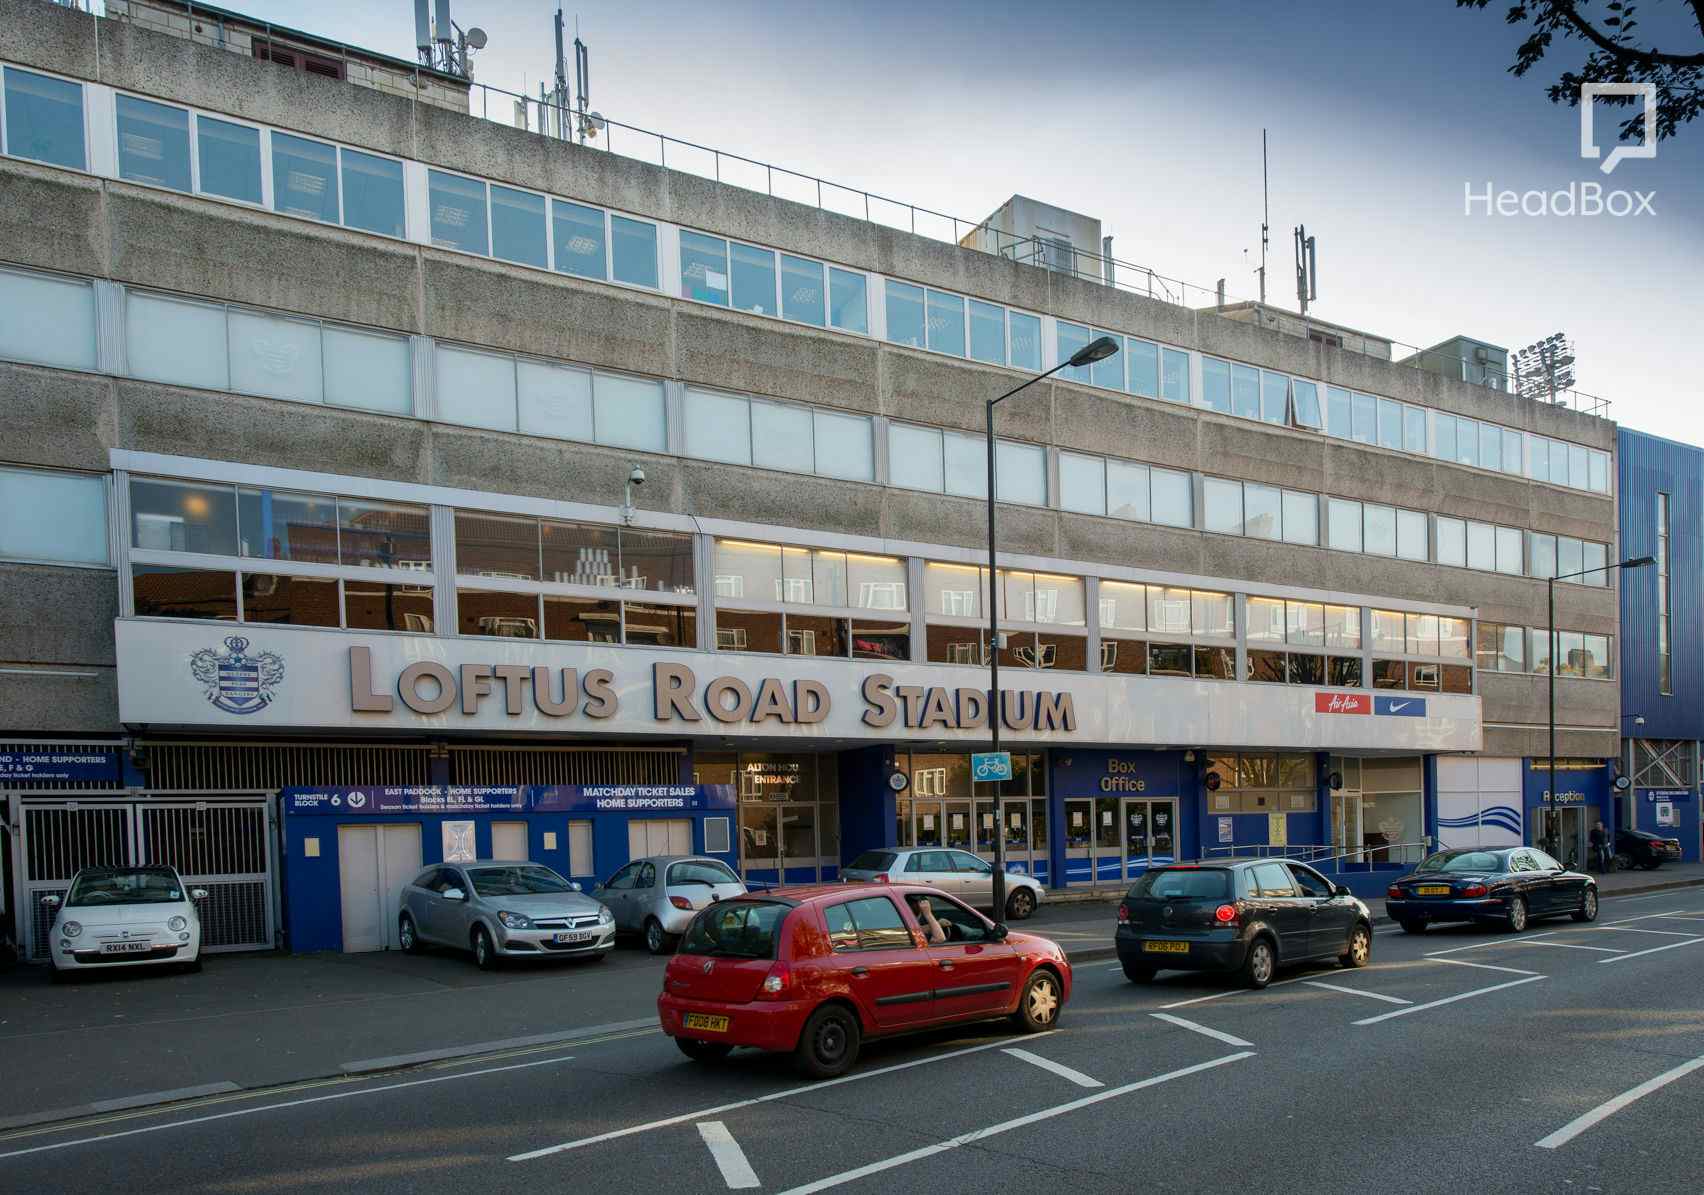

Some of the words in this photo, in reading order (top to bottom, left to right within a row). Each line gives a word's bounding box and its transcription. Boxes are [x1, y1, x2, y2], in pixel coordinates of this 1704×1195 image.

[652, 661, 832, 724] ROAD
[51, 756, 106, 764] SUPPORTERS
[1108, 758, 1137, 774] Box
[755, 775, 800, 784] ENTRANCE
[1100, 776, 1145, 792] Office
[583, 787, 637, 797] MATCHDAY
[638, 787, 669, 796] TICKET
[669, 787, 696, 796] SALES
[1543, 790, 1585, 804] Rception
[330, 794, 341, 807] 6
[420, 796, 445, 804] Blocks
[597, 798, 626, 808] HOME
[627, 798, 684, 808] SUPPORTERS
